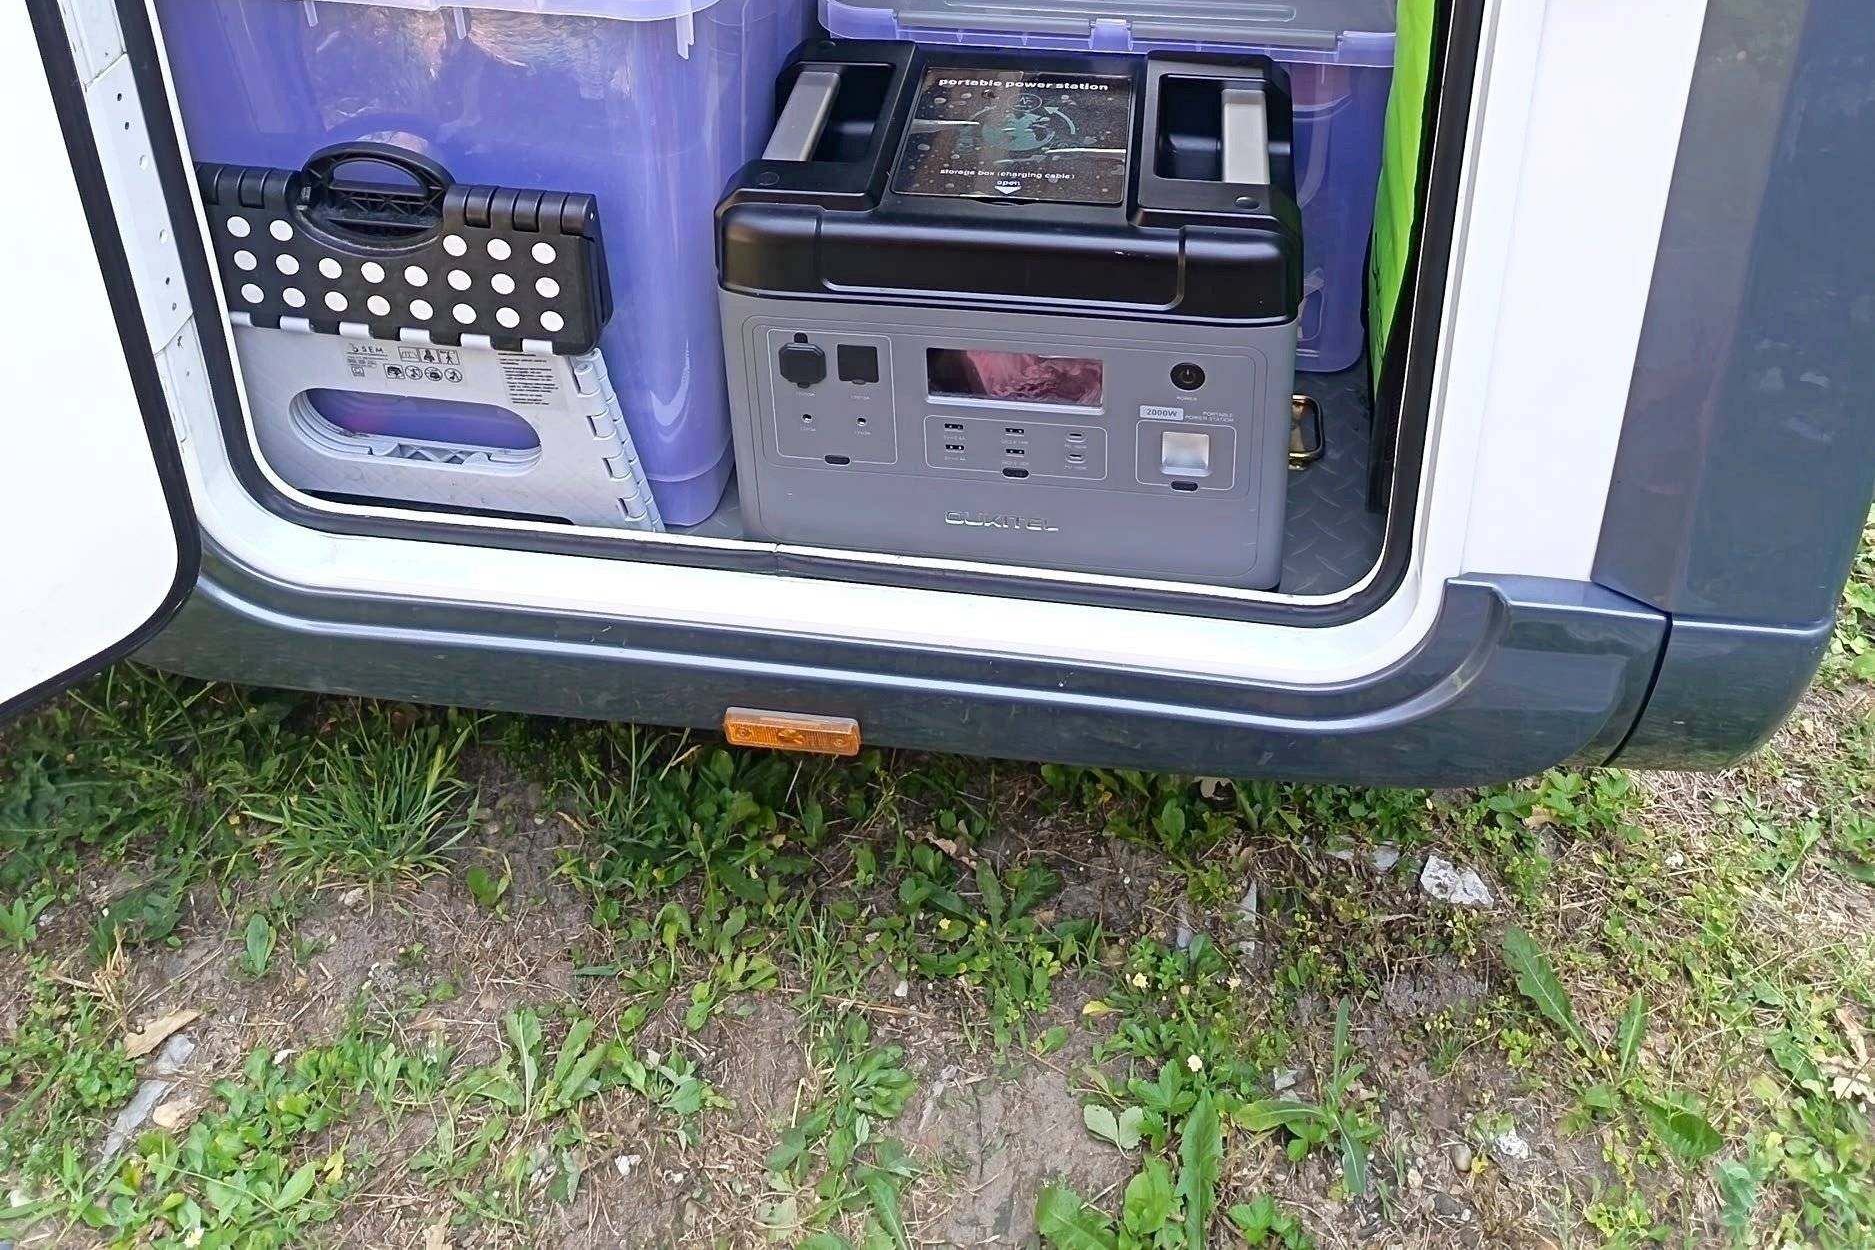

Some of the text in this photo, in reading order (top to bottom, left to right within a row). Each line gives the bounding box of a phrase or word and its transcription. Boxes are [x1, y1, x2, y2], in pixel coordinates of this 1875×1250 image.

[939, 78, 1109, 91] portable power station
[939, 168, 975, 177] storage
[1147, 408, 1177, 418] 2000W
[944, 510, 1059, 531] OUKITEL
